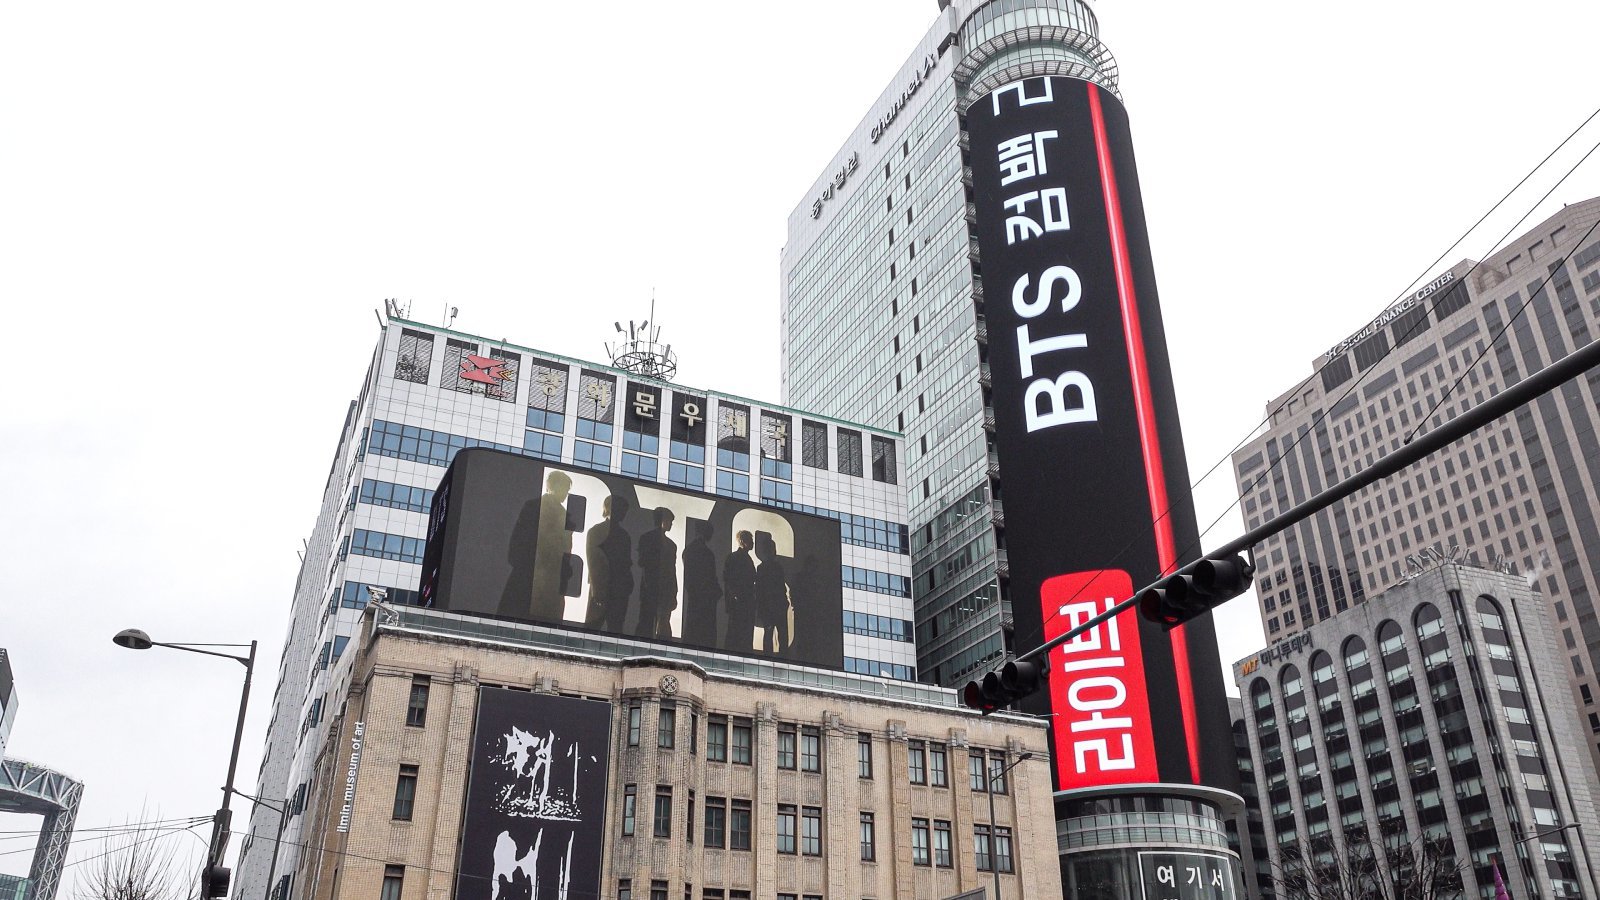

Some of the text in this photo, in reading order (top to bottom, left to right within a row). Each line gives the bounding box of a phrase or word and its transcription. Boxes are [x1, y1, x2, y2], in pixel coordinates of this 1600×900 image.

[871, 69, 922, 144] Channel
[810, 151, 859, 220] 동아일보
[998, 130, 1071, 246] 컴백
[1341, 327, 1372, 351] SEOUL
[1373, 298, 1415, 331] FINANCE
[1415, 271, 1455, 301] CENTER
[1012, 265, 1098, 433] BTS
[1242, 656, 1259, 676] MT
[1260, 630, 1313, 667] 머니투데이
[1059, 597, 1136, 774] 라이브
[351, 738, 361, 751] of
[354, 721, 364, 736] art
[344, 753, 359, 801] museum
